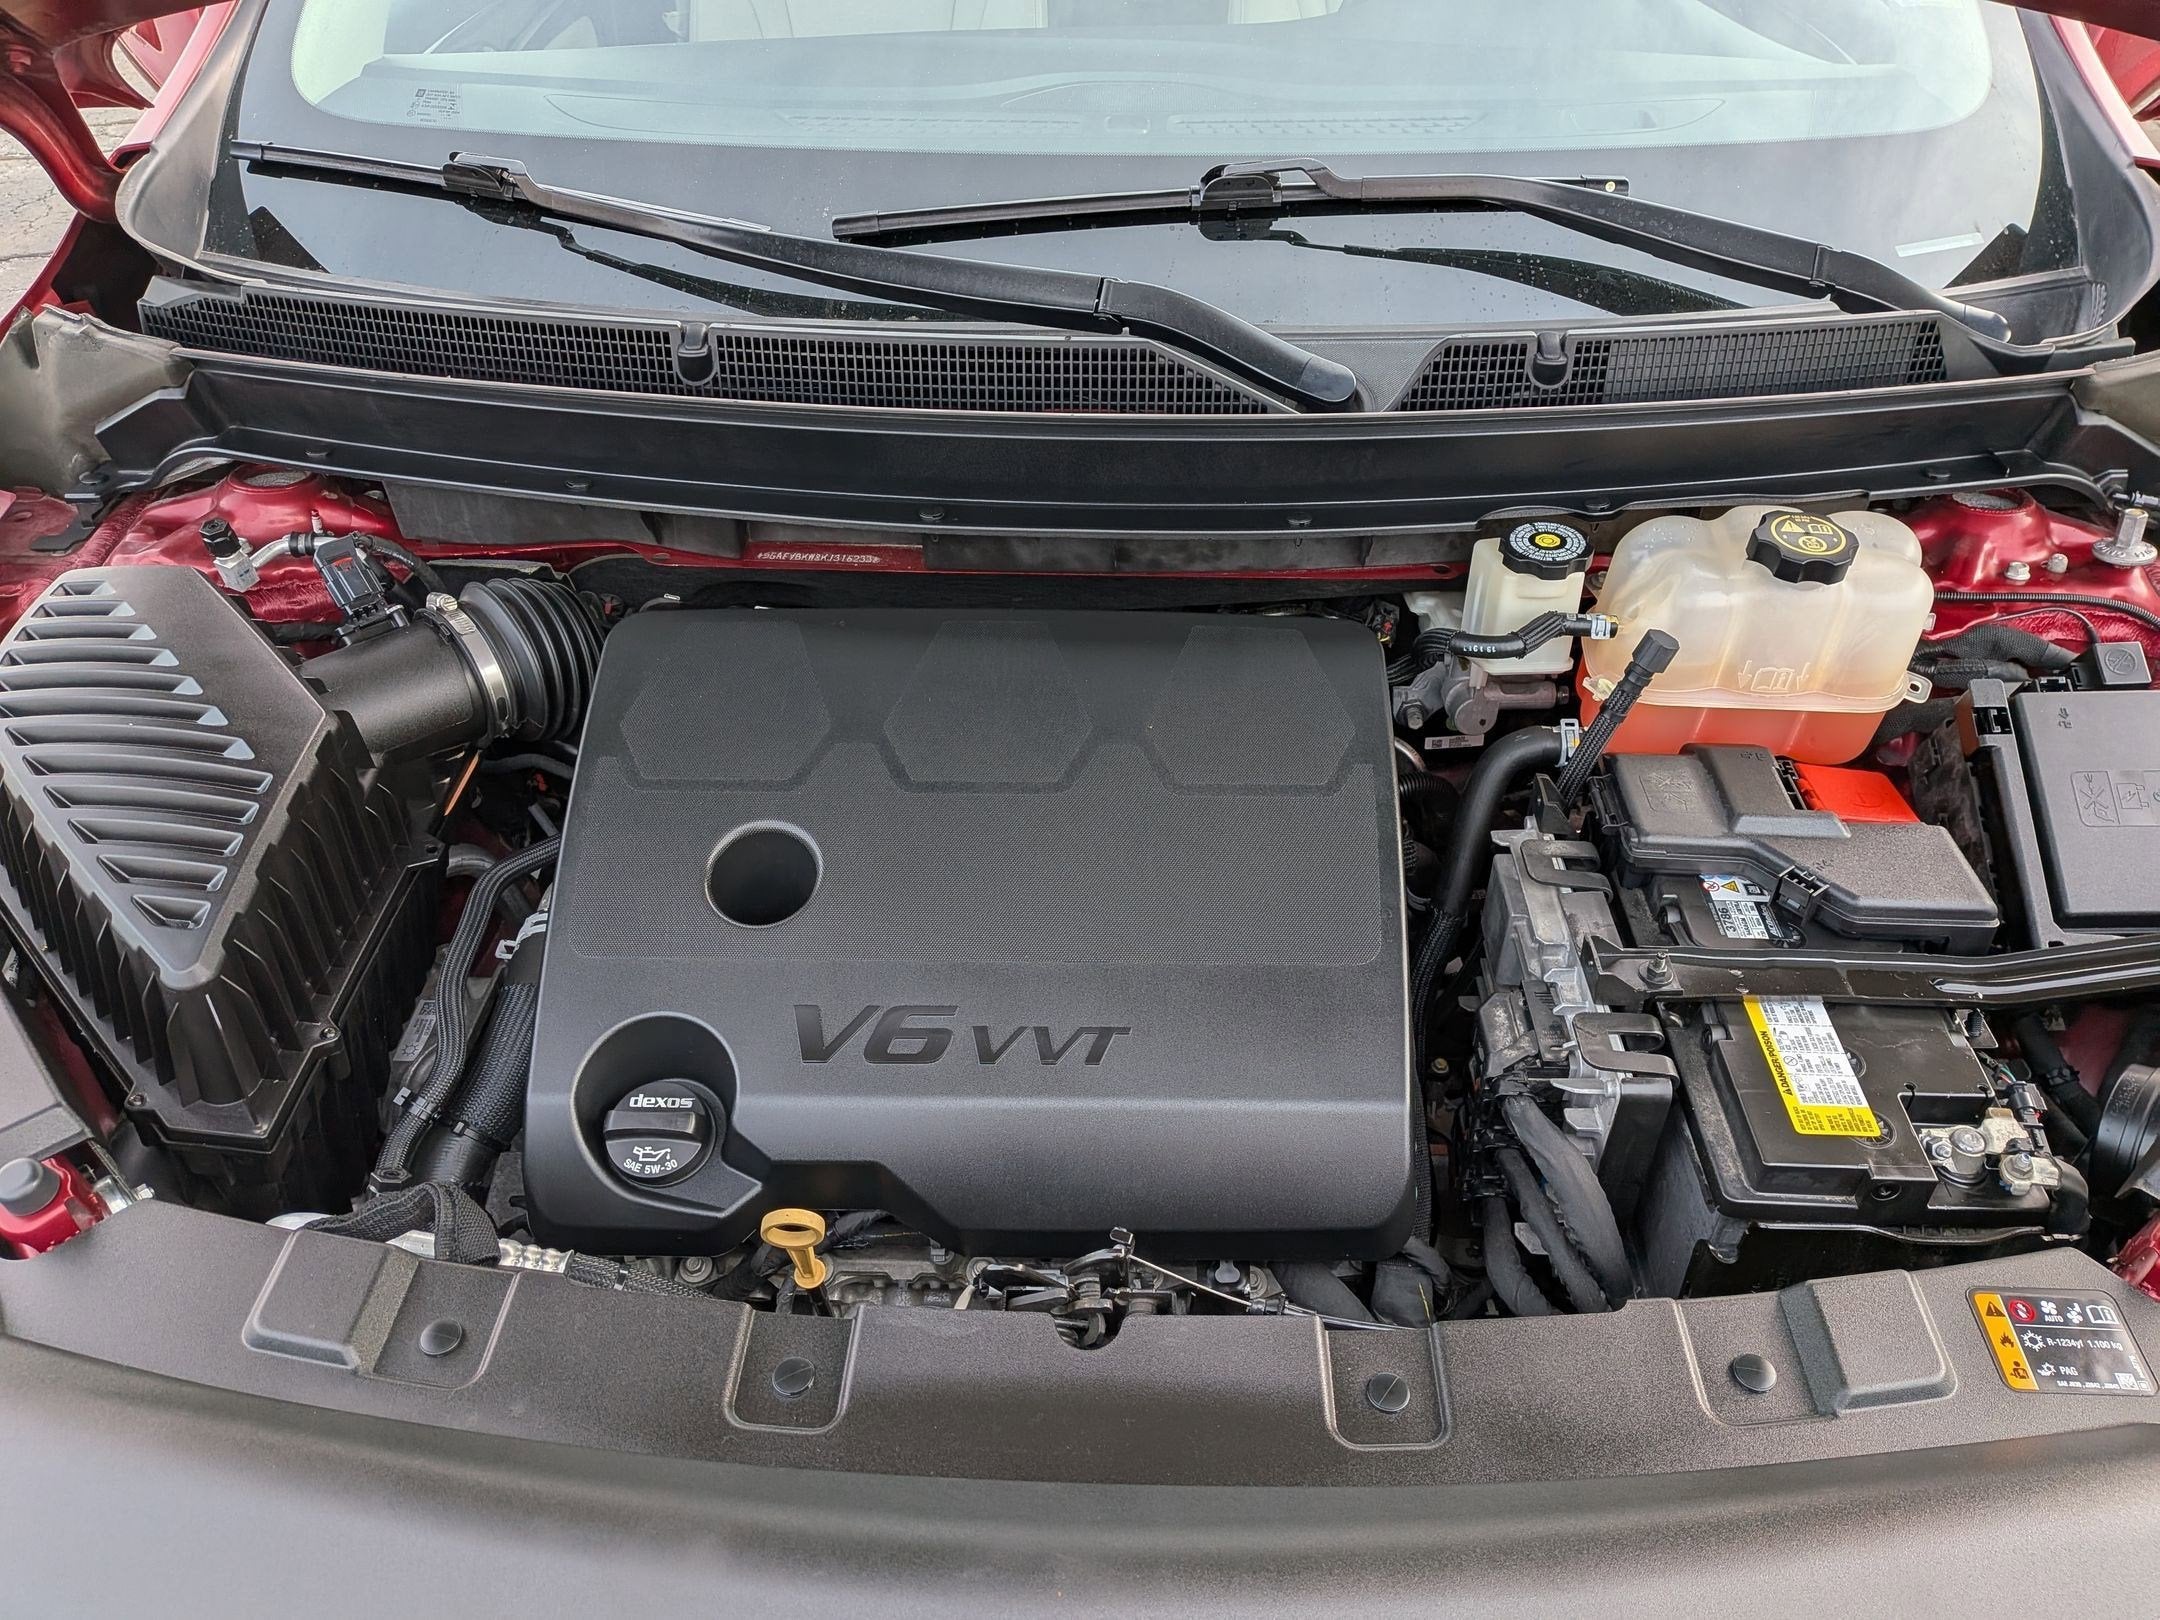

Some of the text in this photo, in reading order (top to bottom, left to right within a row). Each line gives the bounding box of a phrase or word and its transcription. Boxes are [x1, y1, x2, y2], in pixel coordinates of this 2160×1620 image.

[1718, 907, 1736, 933] 3786
[793, 1004, 1132, 1066] V6 VVT
[629, 1093, 696, 1109] dexos
[623, 1158, 678, 1174] SAE 5W-30
[2044, 1314, 2064, 1323] AUTO
[2087, 1339, 2111, 1349] 1.100
[2111, 1340, 2123, 1351] kg
[2058, 1365, 2078, 1376] PAG
